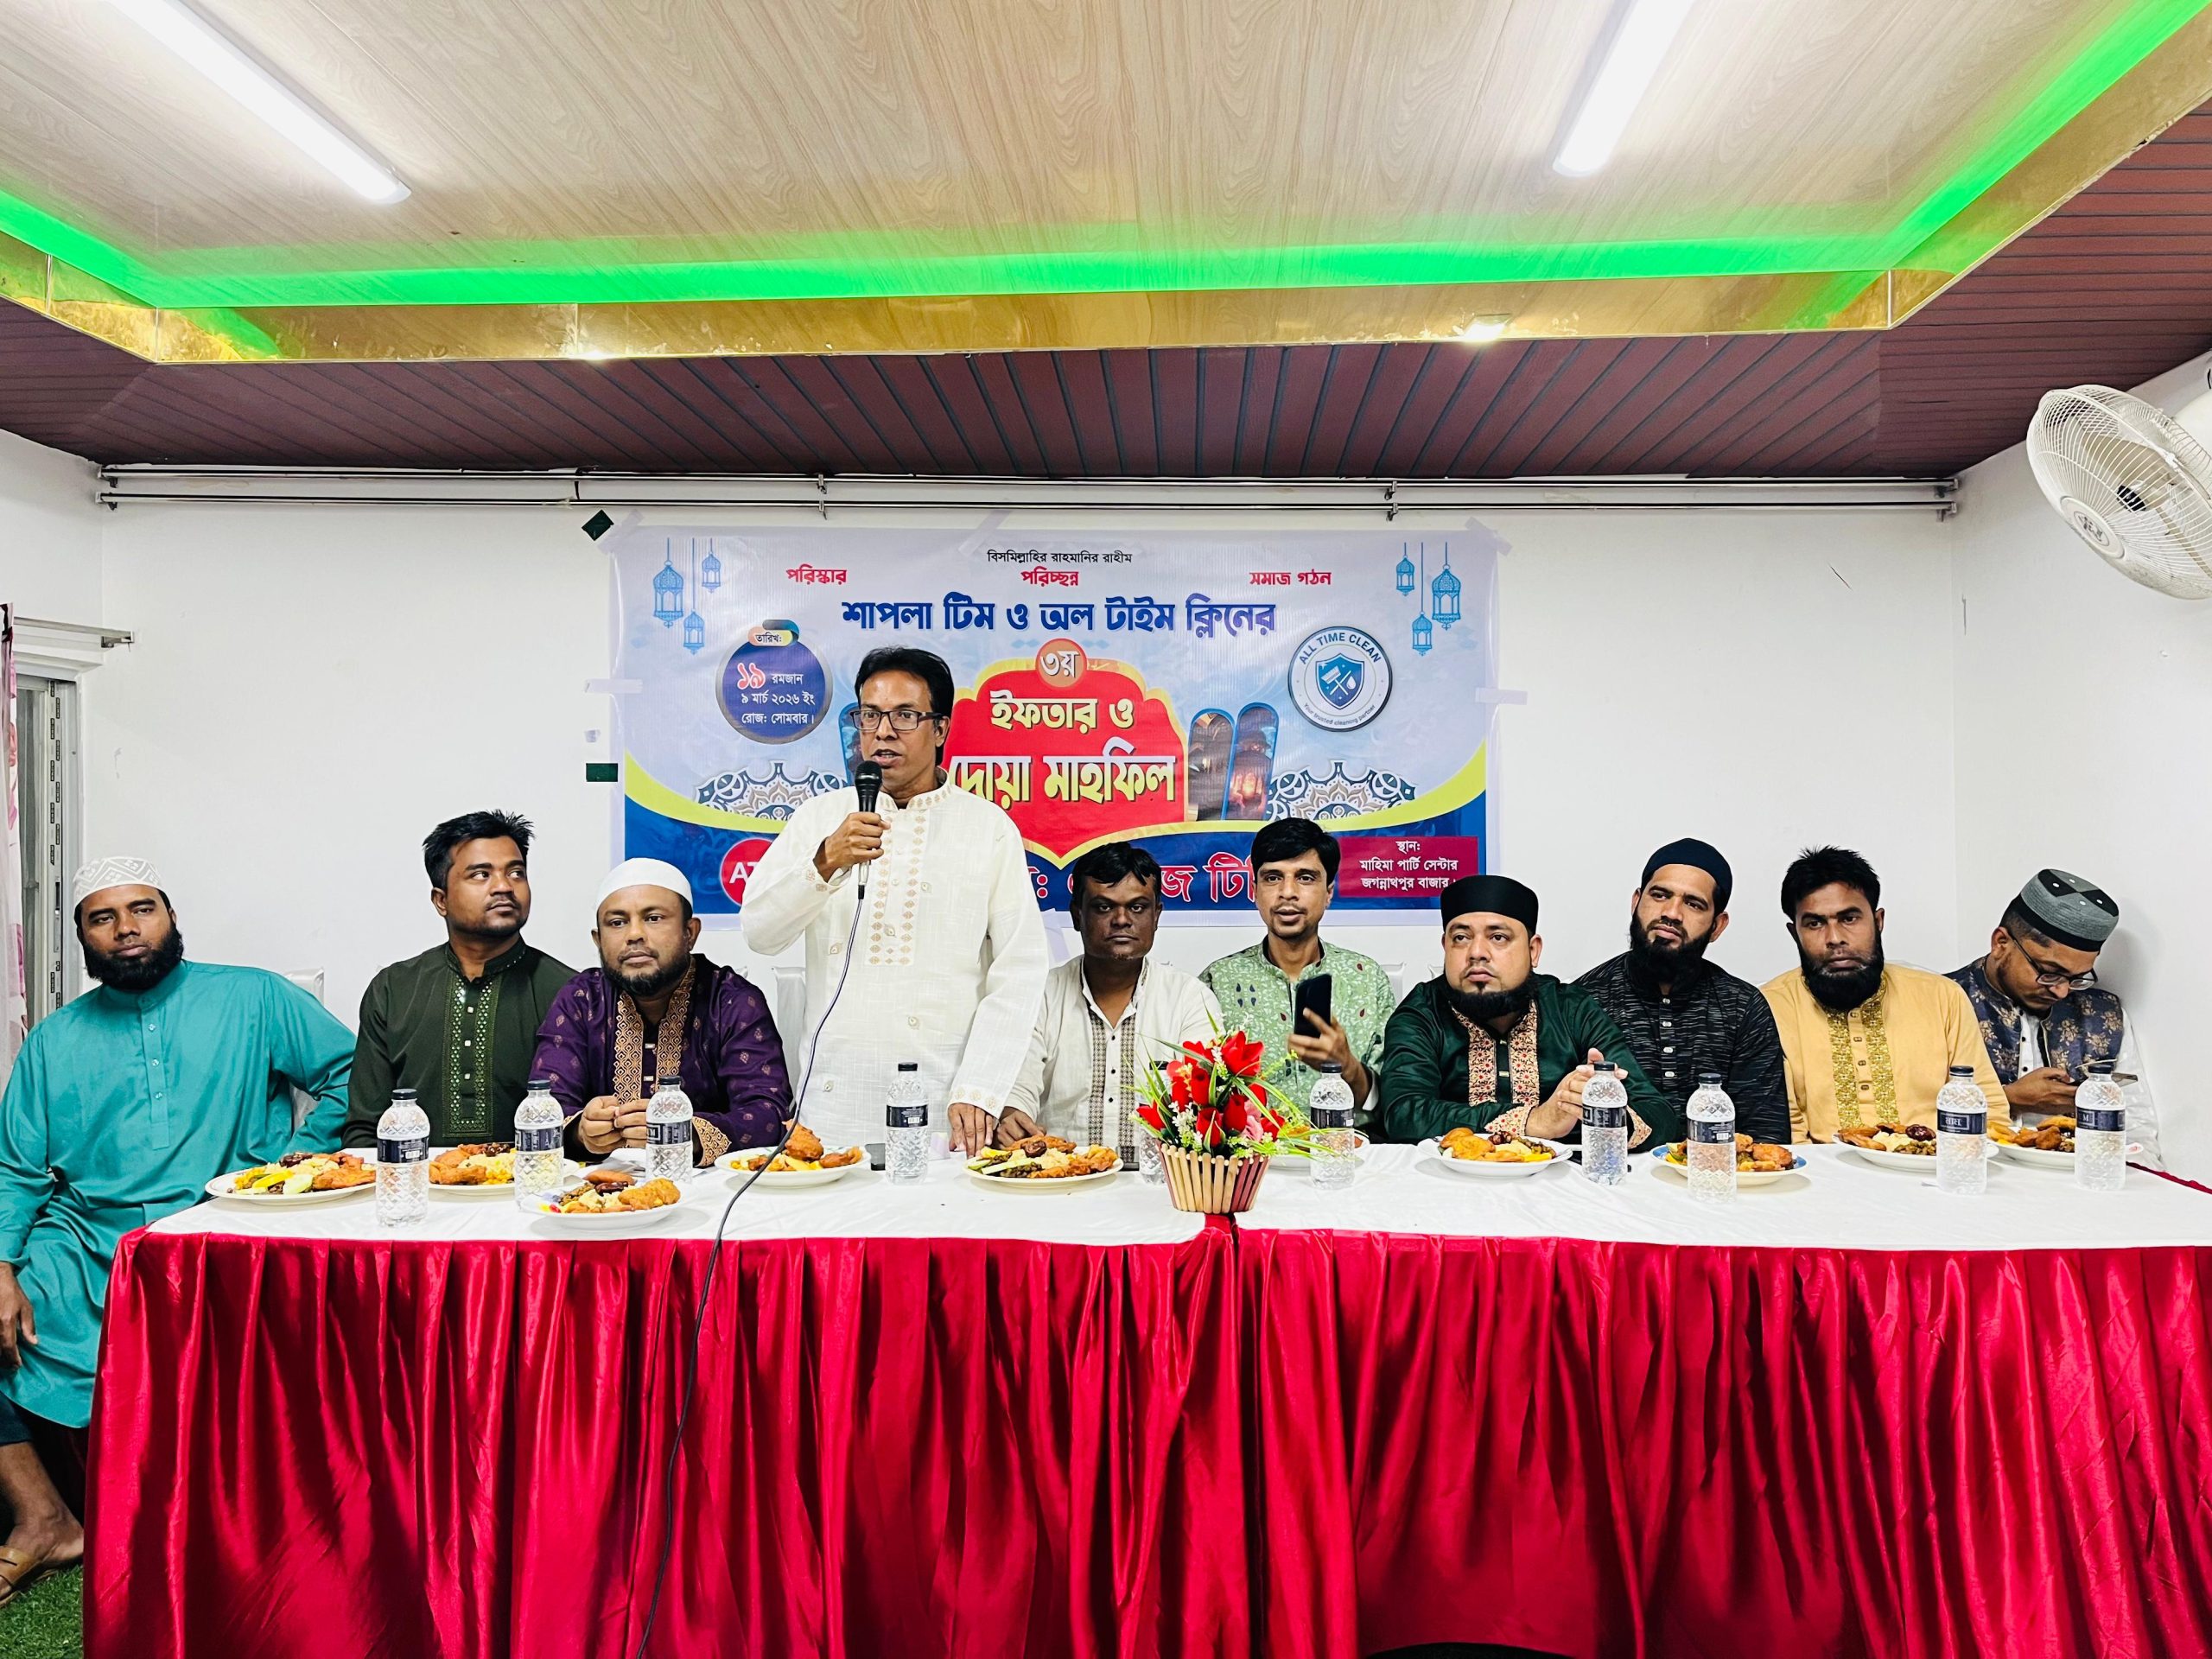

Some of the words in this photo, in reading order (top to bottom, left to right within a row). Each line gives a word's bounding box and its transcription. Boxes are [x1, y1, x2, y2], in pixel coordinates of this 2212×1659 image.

[987, 549, 1047, 563] বিসমিল্লাহির
[1051, 550, 1098, 563] রাহমানির
[1102, 550, 1133, 563] রাহীম
[1020, 566, 1079, 588] পরিচ্ছন্ন
[1249, 571, 1291, 586] সমাজ
[1297, 570, 1332, 586] গঠন
[842, 601, 932, 630] শাপলা
[943, 591, 995, 631] টিম
[1006, 604, 1029, 631] ও
[1039, 602, 1094, 631] অল
[1105, 596, 1175, 632] টাইম
[1185, 593, 1275, 639] ক্লিনের
[1299, 645, 1318, 665] ALL
[1316, 632, 1346, 646] TIME
[1349, 633, 1382, 664] CLEAN
[736, 662, 766, 690] ১৯
[772, 672, 804, 685] রমজান
[1040, 651, 1079, 677] ৩য়
[741, 693, 748, 704] ৯
[752, 690, 769, 704] মার্চ
[772, 693, 799, 705] ২০২৬
[802, 690, 816, 705] ইং
[989, 689, 1098, 734] ইফতার
[1109, 698, 1135, 728] ও
[1043, 736, 1176, 804] মাহফিল
[1359, 856, 1394, 871] মাহিমা
[1396, 855, 1421, 871] পার্টি
[1423, 857, 1459, 871] সেন্টার
[1360, 876, 1415, 891] জগন্নাথপুর
